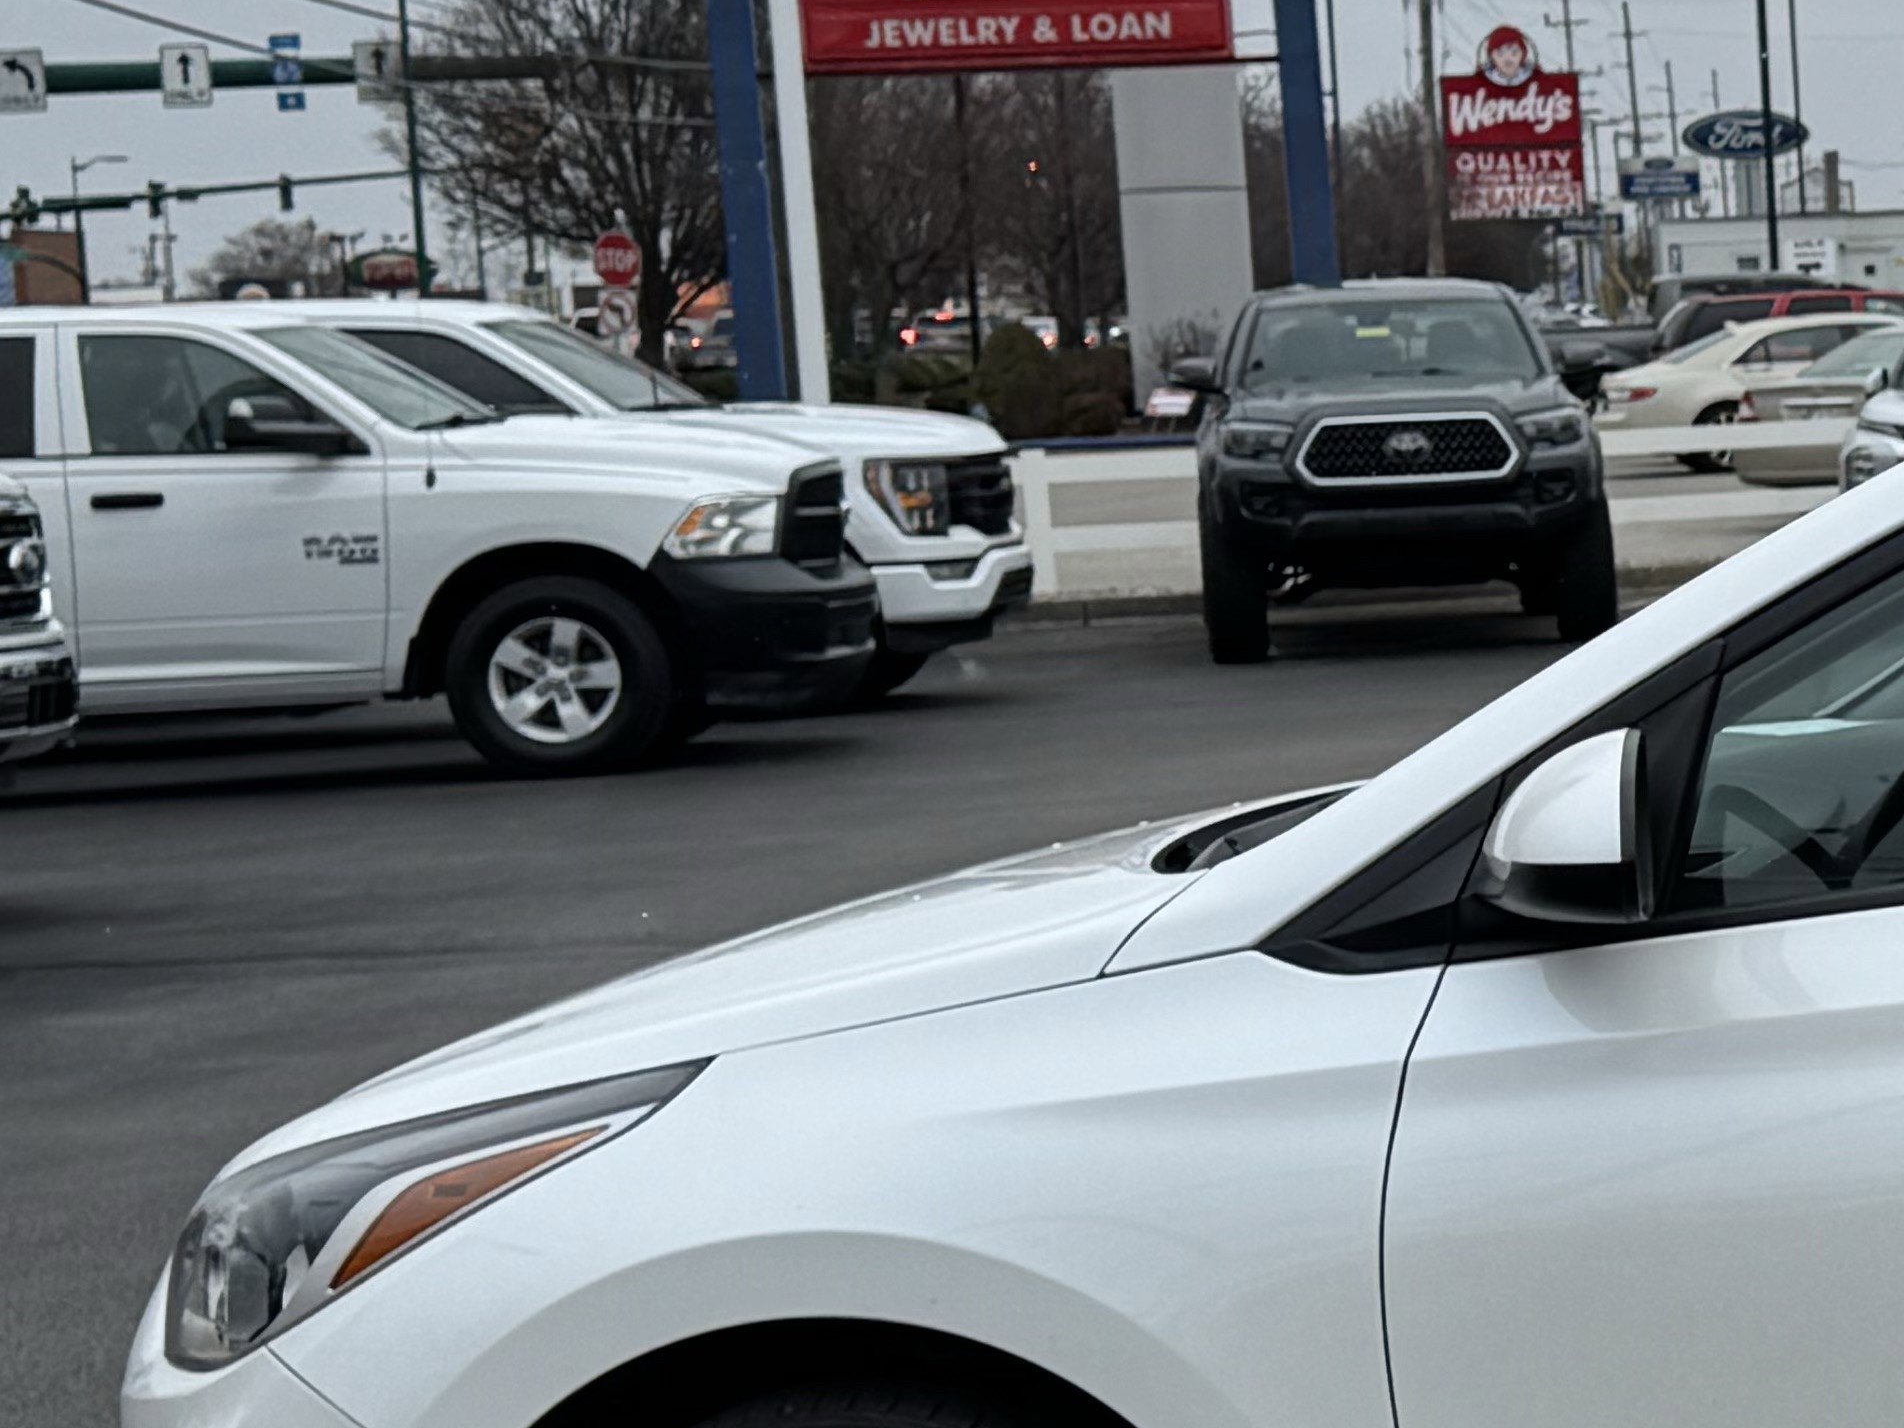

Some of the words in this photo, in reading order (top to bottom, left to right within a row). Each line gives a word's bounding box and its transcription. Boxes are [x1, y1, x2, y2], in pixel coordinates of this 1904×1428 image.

[864, 15, 1018, 49] JEWELRY
[1032, 13, 1059, 44] &
[1071, 11, 1172, 42] LOAN
[1448, 82, 1573, 136] Wendy's
[1456, 149, 1571, 172] QUALITY
[597, 247, 638, 272] STOP
